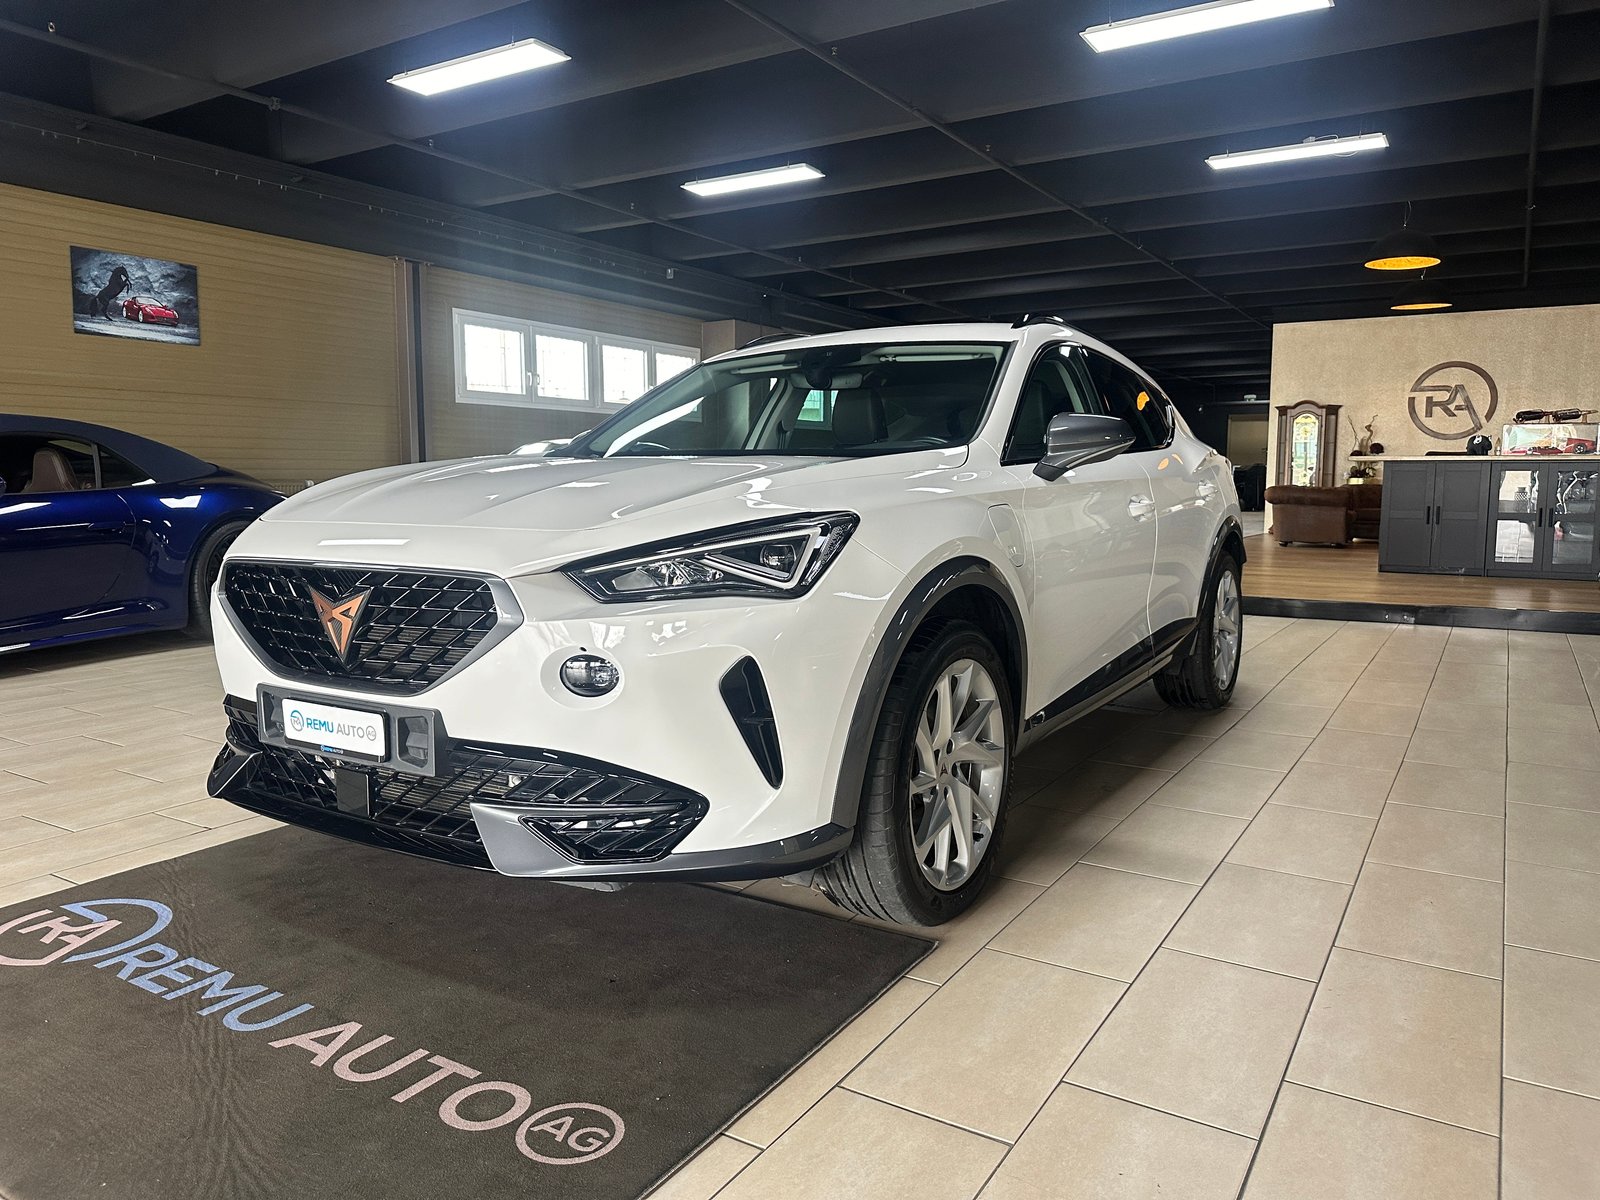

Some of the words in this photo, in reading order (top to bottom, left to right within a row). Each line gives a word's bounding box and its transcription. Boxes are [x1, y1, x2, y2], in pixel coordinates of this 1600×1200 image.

[306, 717, 334, 733] REMU
[336, 723, 365, 739] AUTO
[94, 943, 314, 1031] REMU
[268, 1021, 532, 1131] AUTO
[531, 1116, 611, 1152] AG
